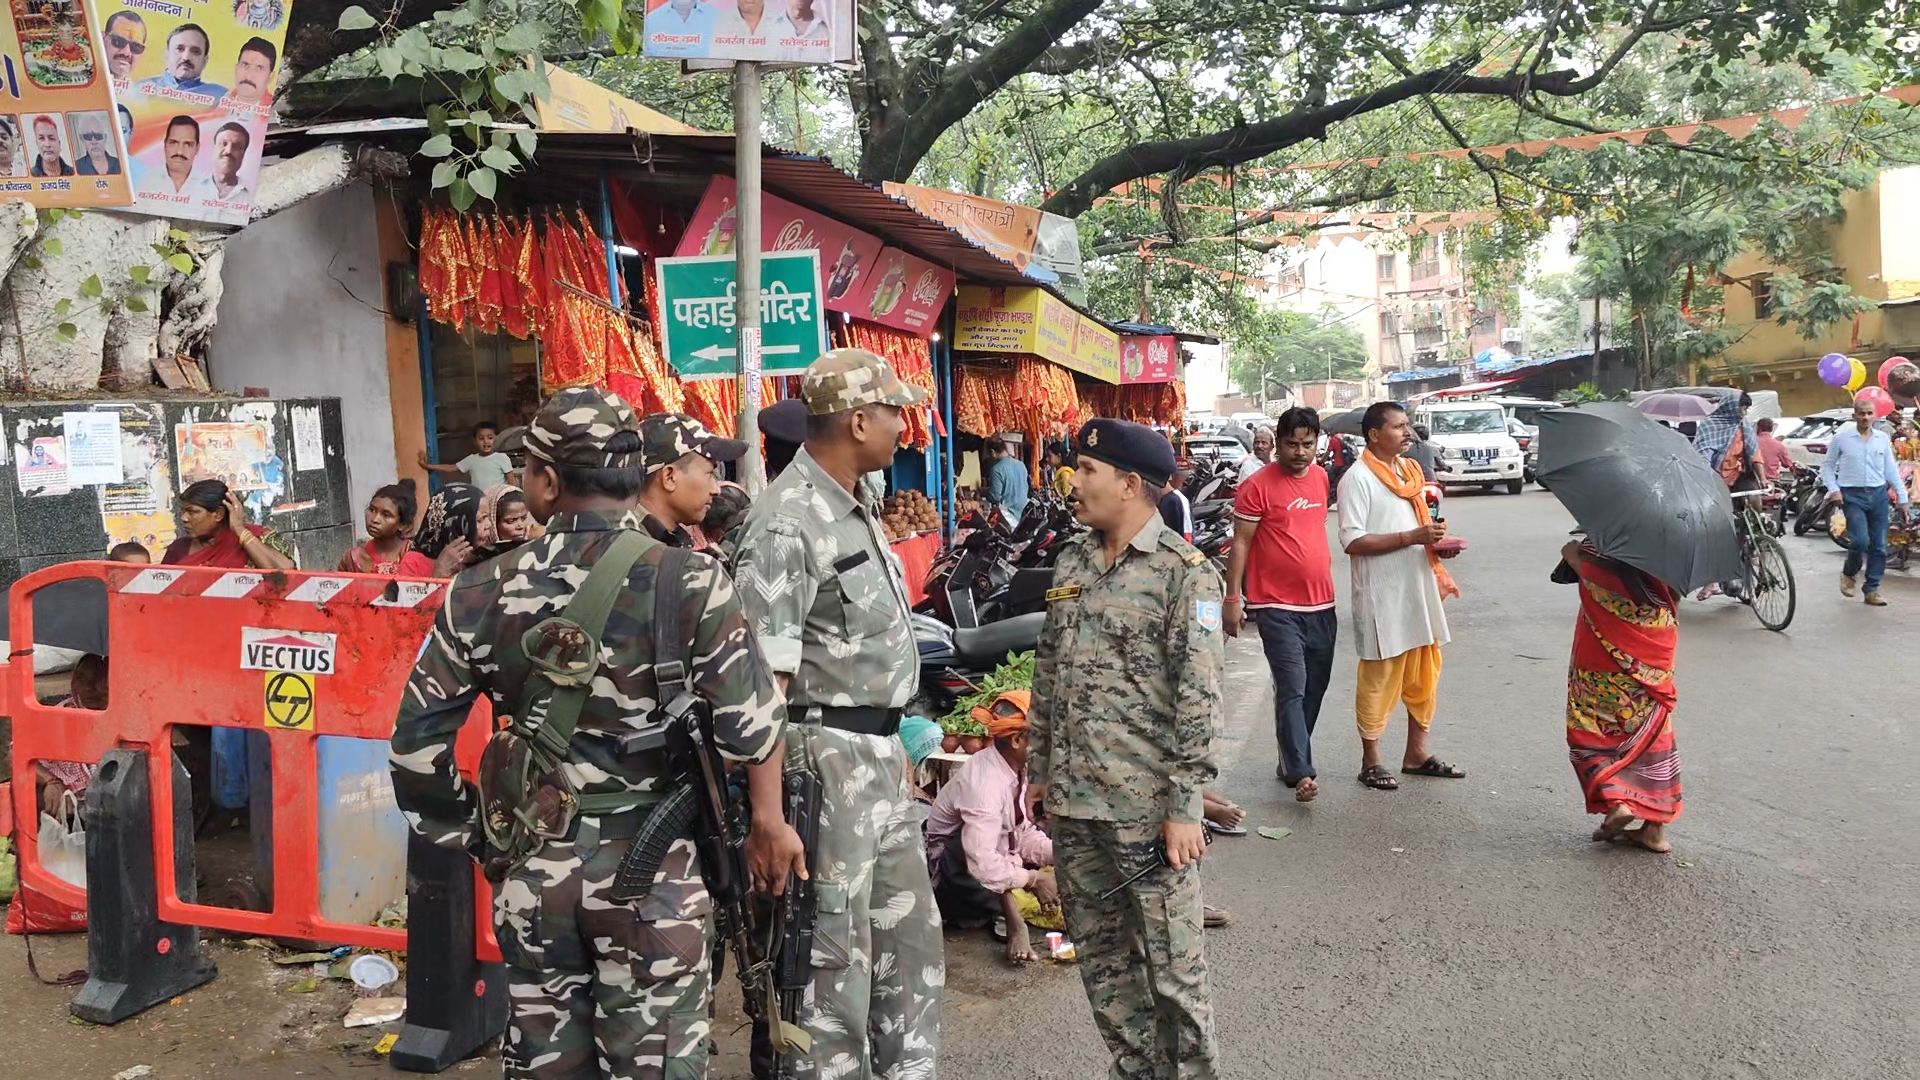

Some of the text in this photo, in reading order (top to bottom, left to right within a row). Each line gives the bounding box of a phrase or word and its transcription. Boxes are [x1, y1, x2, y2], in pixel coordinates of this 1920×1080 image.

[682, 34, 701, 44] वर्मा
[715, 36, 766, 46] बजरंग वर्मा
[812, 38, 830, 48] वर्मा
[247, 643, 331, 672] VECTUS
